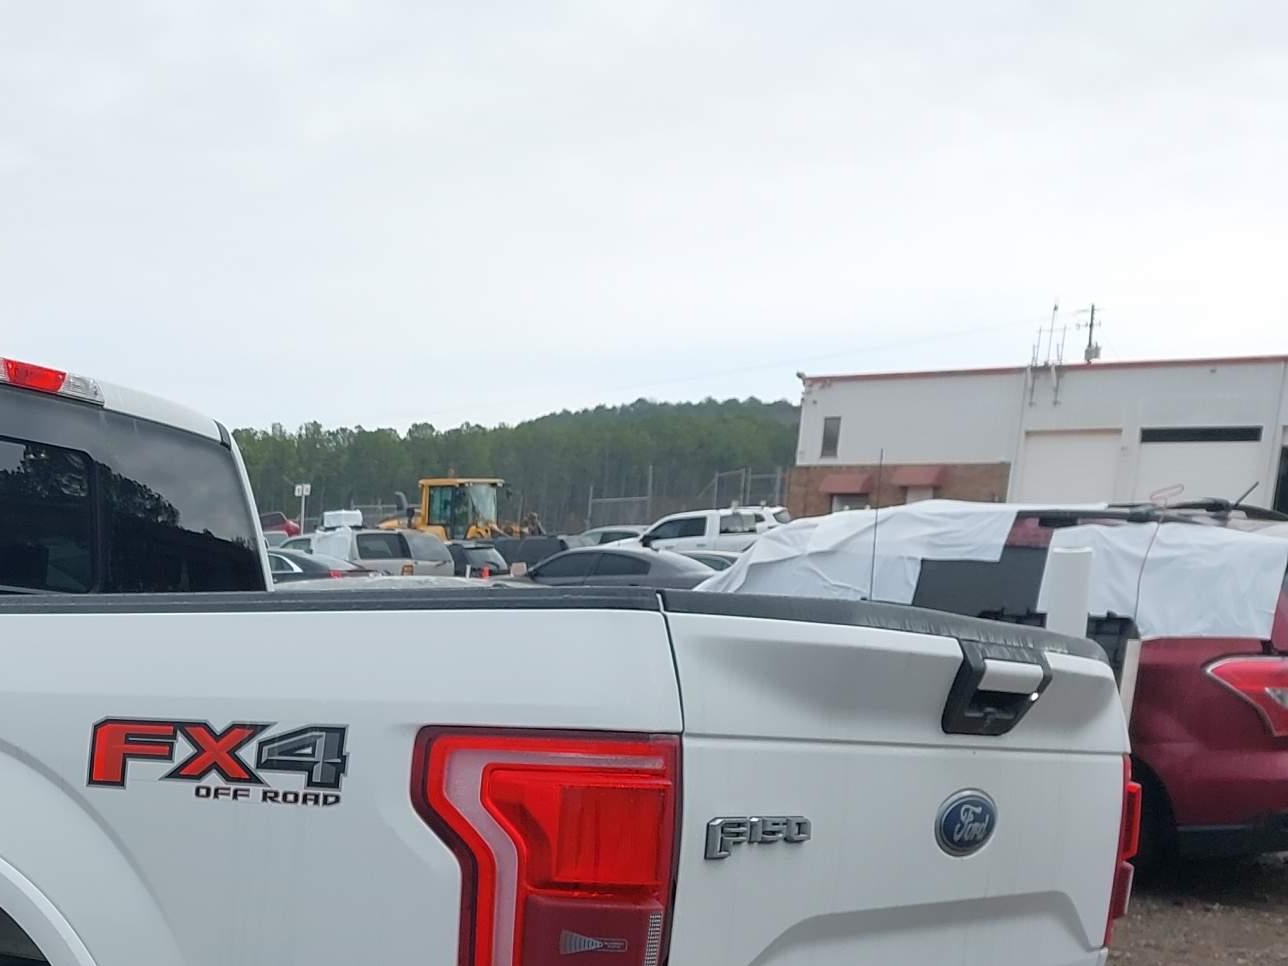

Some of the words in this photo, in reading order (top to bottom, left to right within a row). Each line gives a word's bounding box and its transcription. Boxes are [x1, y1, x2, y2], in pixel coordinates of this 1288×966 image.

[85, 716, 349, 790] FX4
[194, 785, 250, 801] OFF
[261, 789, 341, 807] ROAD
[704, 815, 812, 860] F150
[951, 802, 991, 844] Ford
